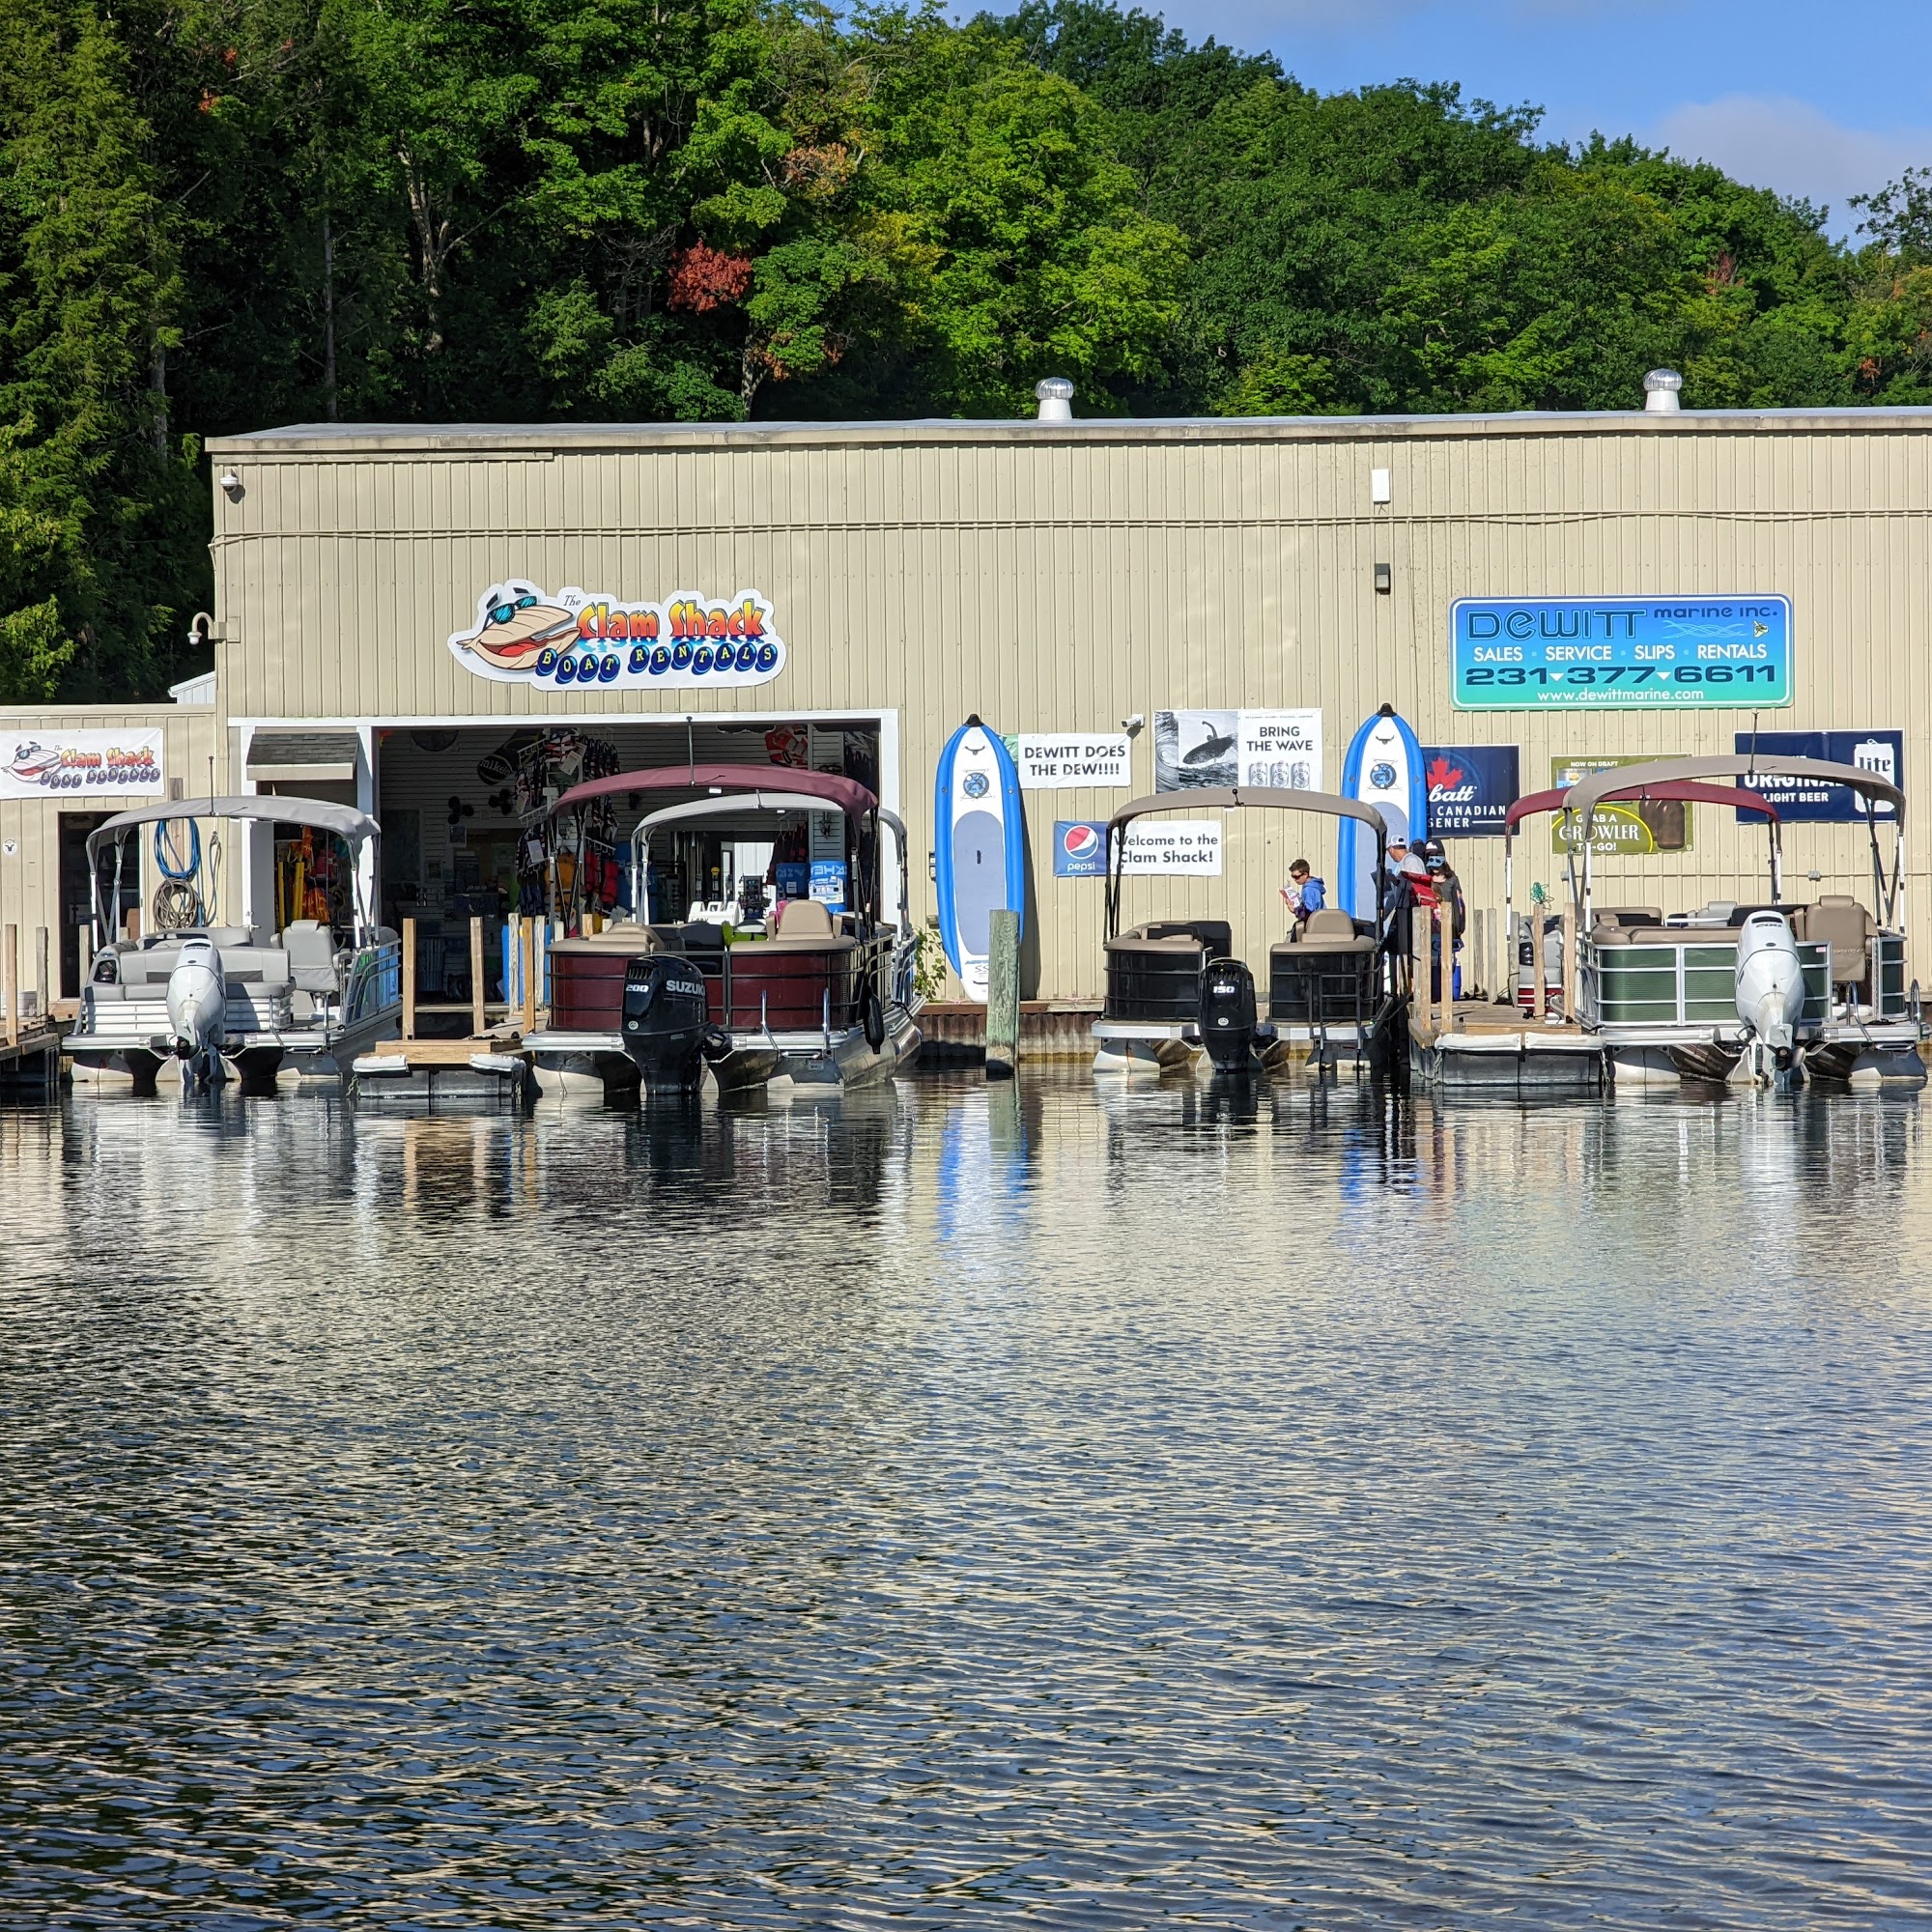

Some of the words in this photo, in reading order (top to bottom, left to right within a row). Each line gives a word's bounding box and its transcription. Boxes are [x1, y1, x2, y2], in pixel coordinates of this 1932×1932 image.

[563, 595, 581, 606] The
[577, 602, 660, 639] Clam
[668, 598, 768, 638] Shack
[1654, 607, 1733, 618] marine
[1740, 606, 1777, 617] inc.
[1473, 646, 1523, 662] SALES
[1546, 645, 1612, 661] SERVICE
[1634, 645, 1675, 660] SLIPS
[1697, 643, 1767, 660] RENTALS
[539, 650, 617, 676] BOAT
[633, 643, 774, 668] RENTALS
[1537, 687, 1704, 703] www.dewittmarine.com
[1260, 726, 1300, 737] BRING
[1024, 746, 1080, 758] DEWITT
[1085, 745, 1125, 757] DOES
[1246, 741, 1272, 752] THE
[1275, 740, 1313, 752] WAVE
[61, 748, 101, 767] Clam
[106, 746, 155, 767] Shack
[1030, 764, 1057, 776] THE
[1063, 763, 1120, 776] DEW!!!!
[42, 773, 81, 786] BOAT
[88, 767, 159, 782] RENTALS
[1429, 783, 1474, 802] batt
[1763, 792, 1796, 803] LIGHT
[1799, 791, 1829, 803] BEER
[1436, 805, 1506, 816] CANADIAN
[1428, 817, 1470, 828] SENER
[1576, 813, 1605, 823] GAB
[1608, 813, 1617, 823] A
[1114, 835, 1175, 846] Welcome
[1179, 836, 1193, 845] to
[1197, 834, 1218, 845] the
[1577, 842, 1617, 851] T-GO!
[1121, 850, 1157, 863] Clam
[1162, 850, 1213, 863] Shack!
[1067, 861, 1095, 872] pepsi
[625, 984, 649, 993] 200
[666, 980, 705, 997] SUZUKI
[1212, 985, 1236, 994] 150
